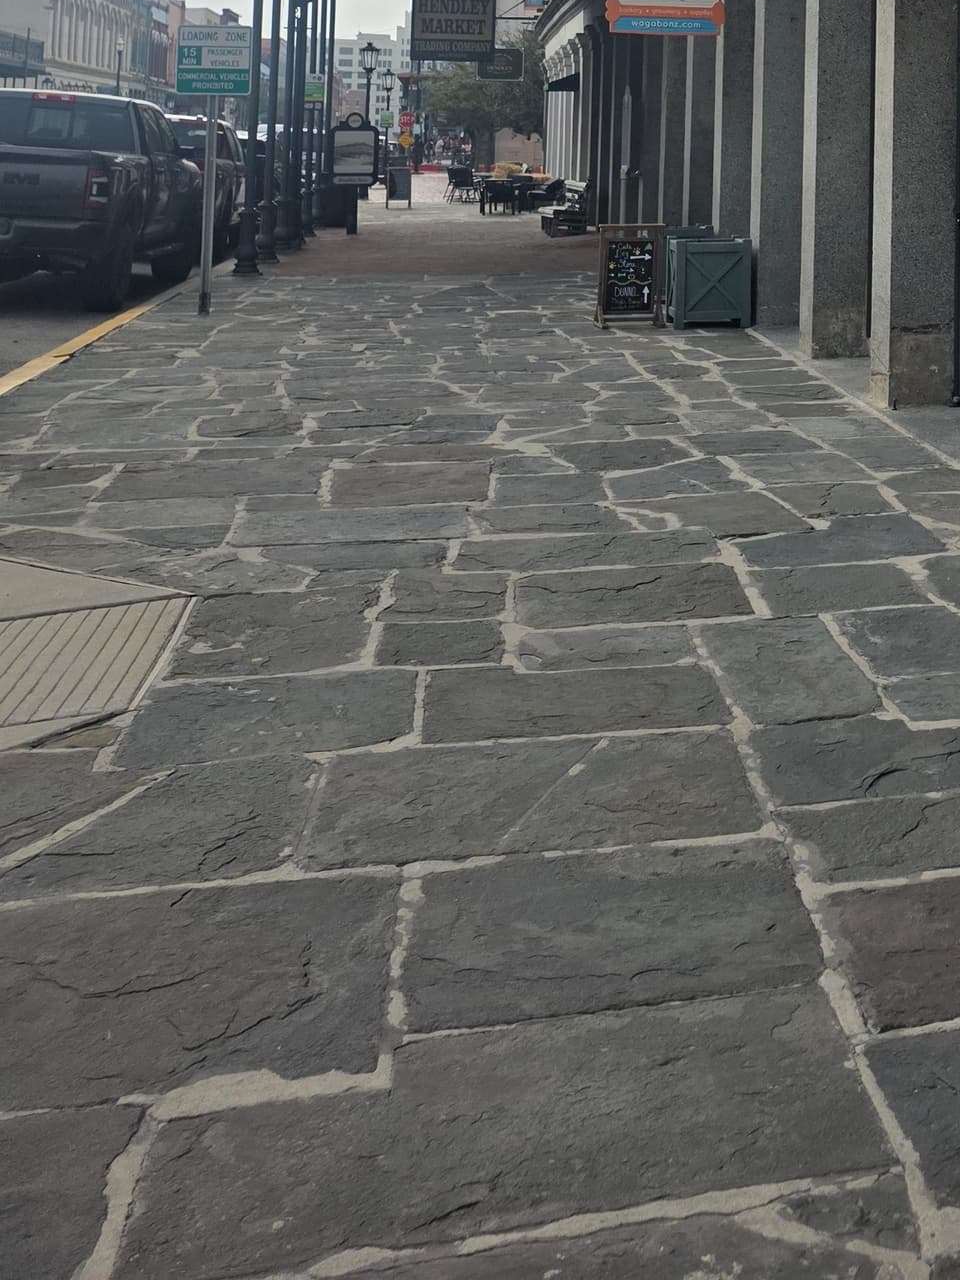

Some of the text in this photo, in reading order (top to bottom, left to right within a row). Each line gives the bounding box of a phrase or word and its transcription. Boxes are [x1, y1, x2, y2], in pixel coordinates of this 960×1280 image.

[422, 18, 486, 35] MARKET
[631, 19, 701, 29] wagabonz.com
[182, 31, 248, 41] LOADING ZONE
[183, 47, 197, 57] 15
[182, 57, 197, 65] MIN
